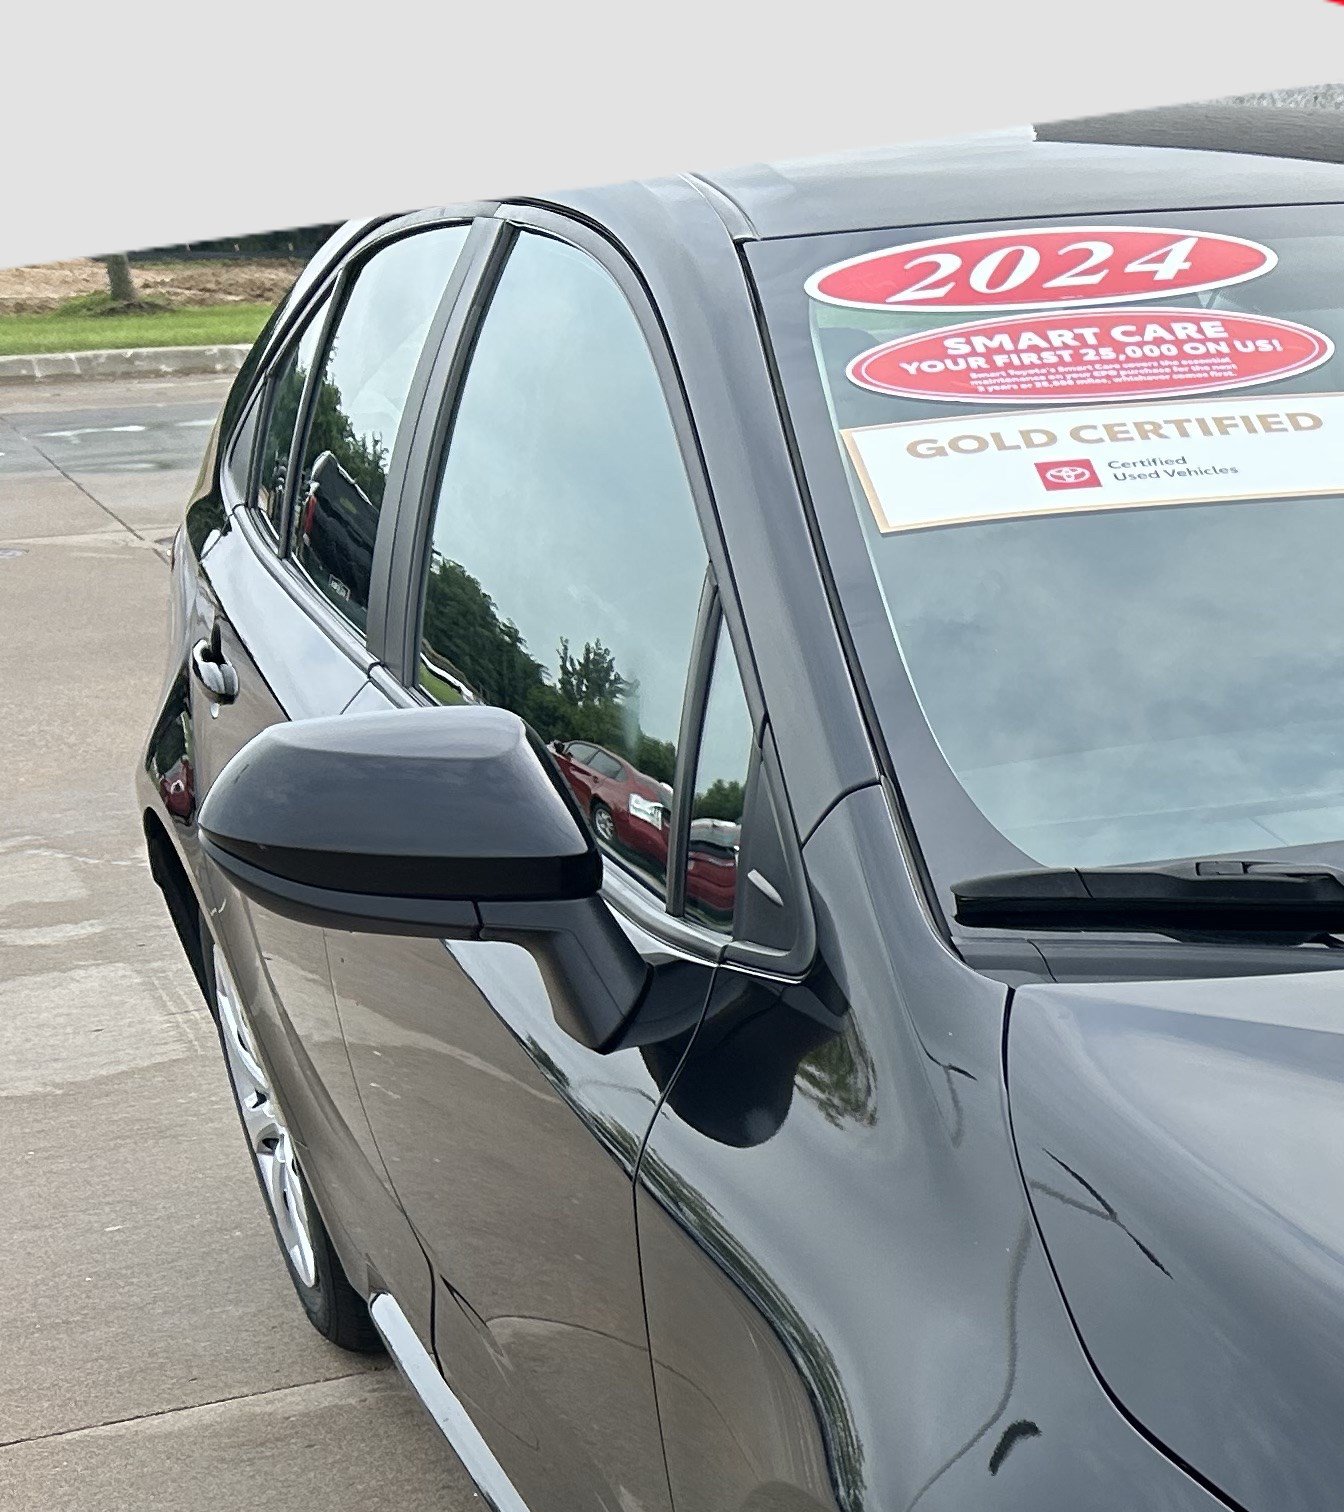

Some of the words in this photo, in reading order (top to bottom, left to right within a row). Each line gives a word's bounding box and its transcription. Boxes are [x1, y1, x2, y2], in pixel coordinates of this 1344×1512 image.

[886, 236, 1199, 304] 2024
[943, 327, 1100, 355] SMART
[1111, 320, 1229, 343] CARE
[899, 357, 990, 375] YOUR
[992, 350, 1074, 367] FIRST
[1080, 343, 1178, 362] 25,000
[1183, 341, 1231, 355] ON
[1233, 338, 1283, 353] US!
[906, 428, 1057, 459] GOLD
[1069, 412, 1323, 444] CERTIFIED
[1108, 455, 1187, 470] Certified
[1113, 469, 1161, 482] Used
[1163, 464, 1239, 479] Vehicles
